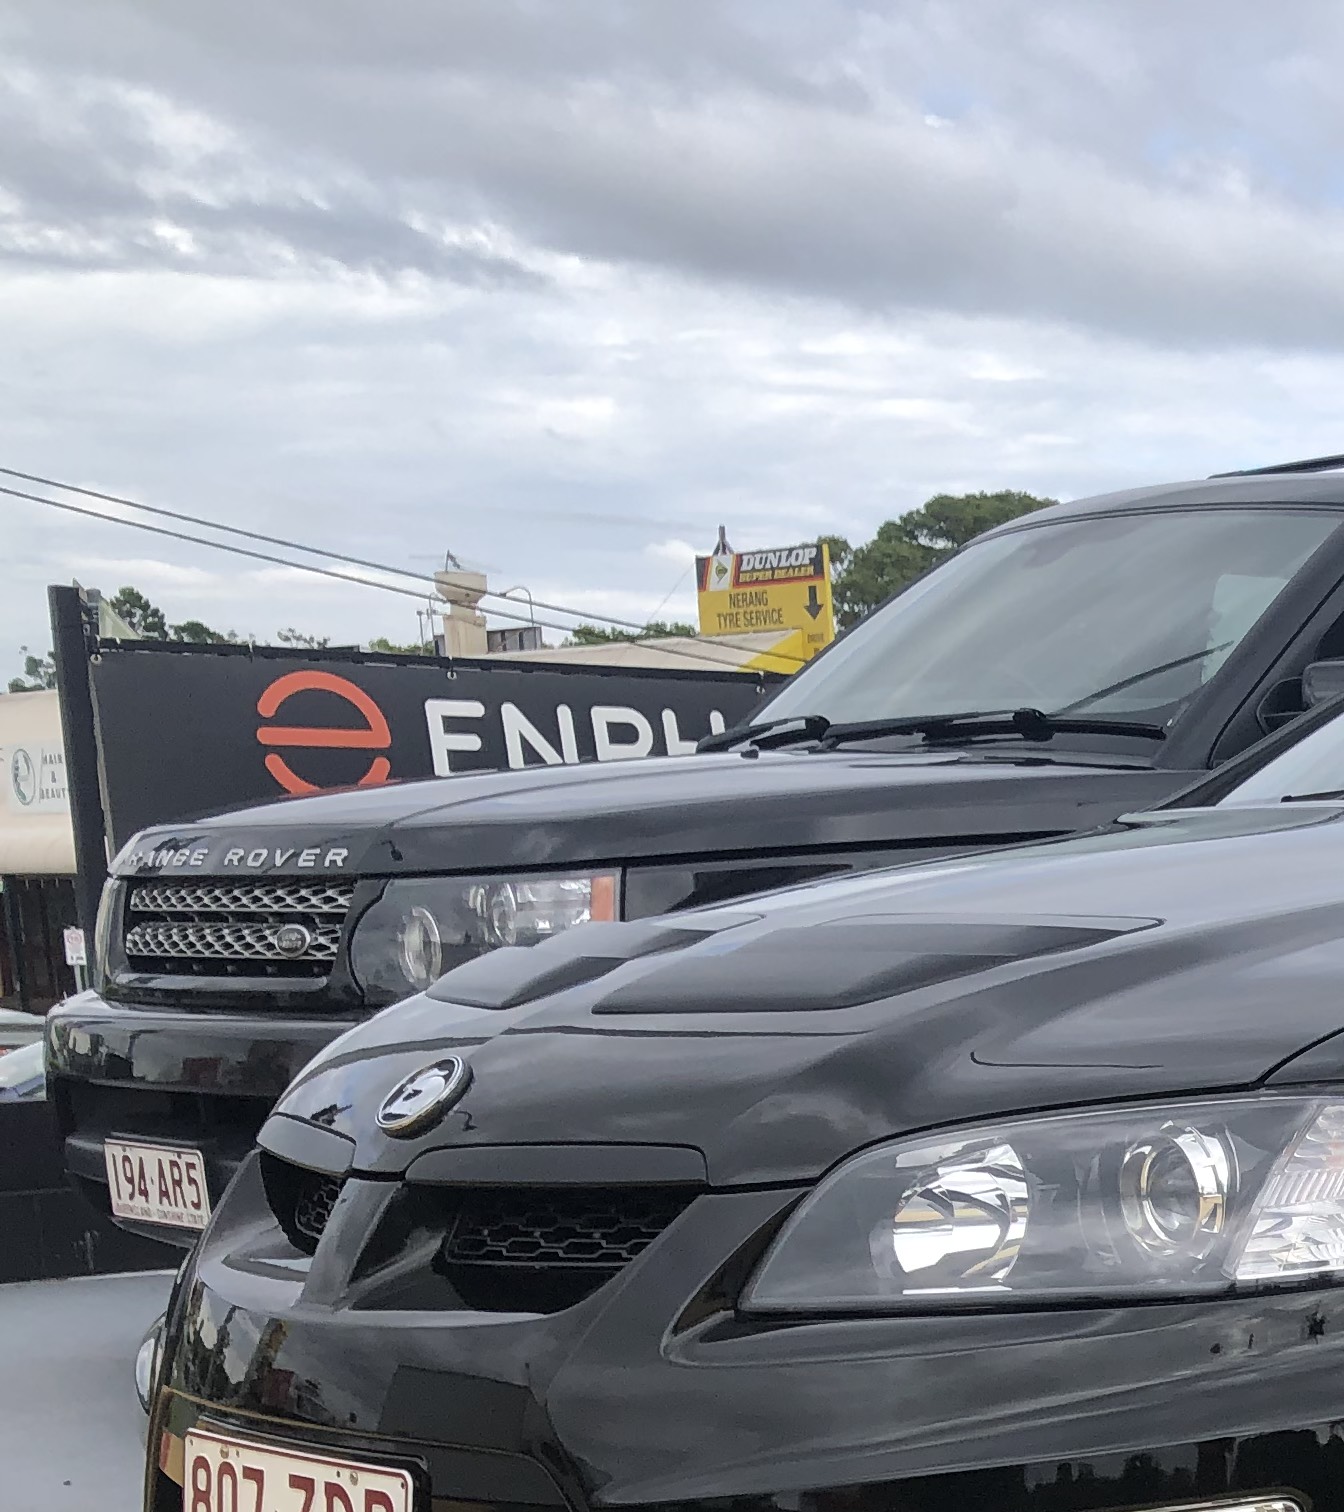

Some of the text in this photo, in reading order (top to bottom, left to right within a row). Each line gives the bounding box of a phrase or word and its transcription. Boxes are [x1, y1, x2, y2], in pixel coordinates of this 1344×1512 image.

[740, 548, 817, 571] DUNLOP
[728, 590, 769, 609] NERANG
[716, 608, 784, 630] TYRE SERVICE
[223, 848, 349, 868] ROVER
